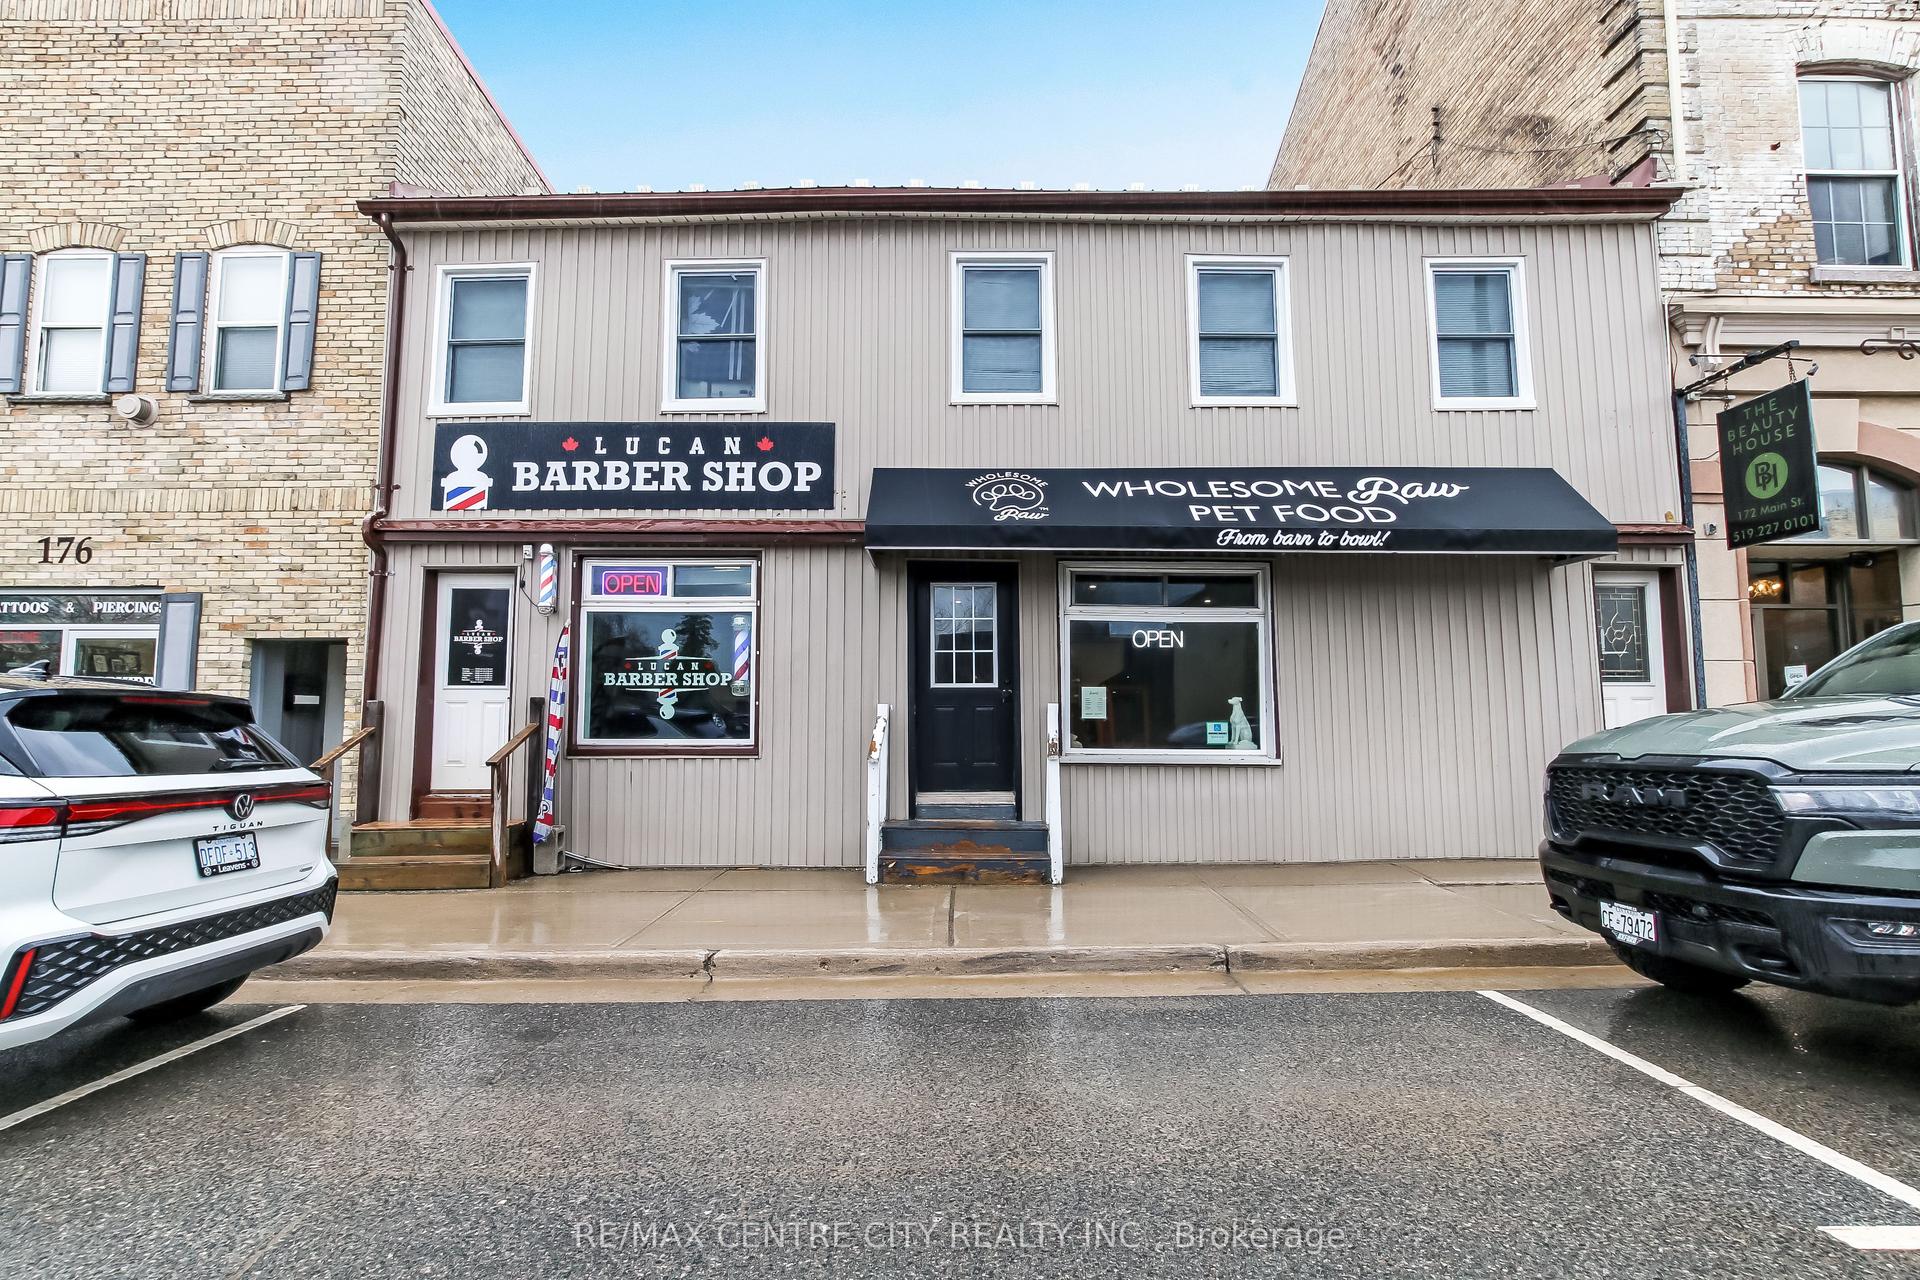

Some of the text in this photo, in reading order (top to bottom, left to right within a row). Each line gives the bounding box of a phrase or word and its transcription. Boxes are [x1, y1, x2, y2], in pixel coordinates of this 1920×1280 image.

[1744, 398, 1778, 420] THE
[1727, 406, 1799, 442] BEAUTY
[595, 437, 741, 455] LUCAN
[1732, 423, 1796, 456] HOUSE
[512, 461, 822, 492] BARBER SHOP
[965, 471, 1049, 487] WHOLESOME
[1082, 477, 1470, 504] WHOLESOME Raw
[993, 508, 1050, 521] Raw
[1188, 503, 1397, 523] PET FOOD
[1737, 507, 1757, 521] 172
[1760, 501, 1788, 517] Main
[1216, 528, 1391, 546] From barn to bowl!
[37, 536, 93, 565] 176
[604, 574, 660, 593] OPEN
[0, 601, 161, 614] TTOOS & PIERCING
[1132, 629, 1184, 648] OPEN
[637, 662, 699, 671] LUCAN
[603, 673, 733, 686] BARBER SHOP
[1582, 783, 1688, 807] RAM
[212, 821, 264, 832] TIGUAN
[218, 862, 247, 873] Leavens
